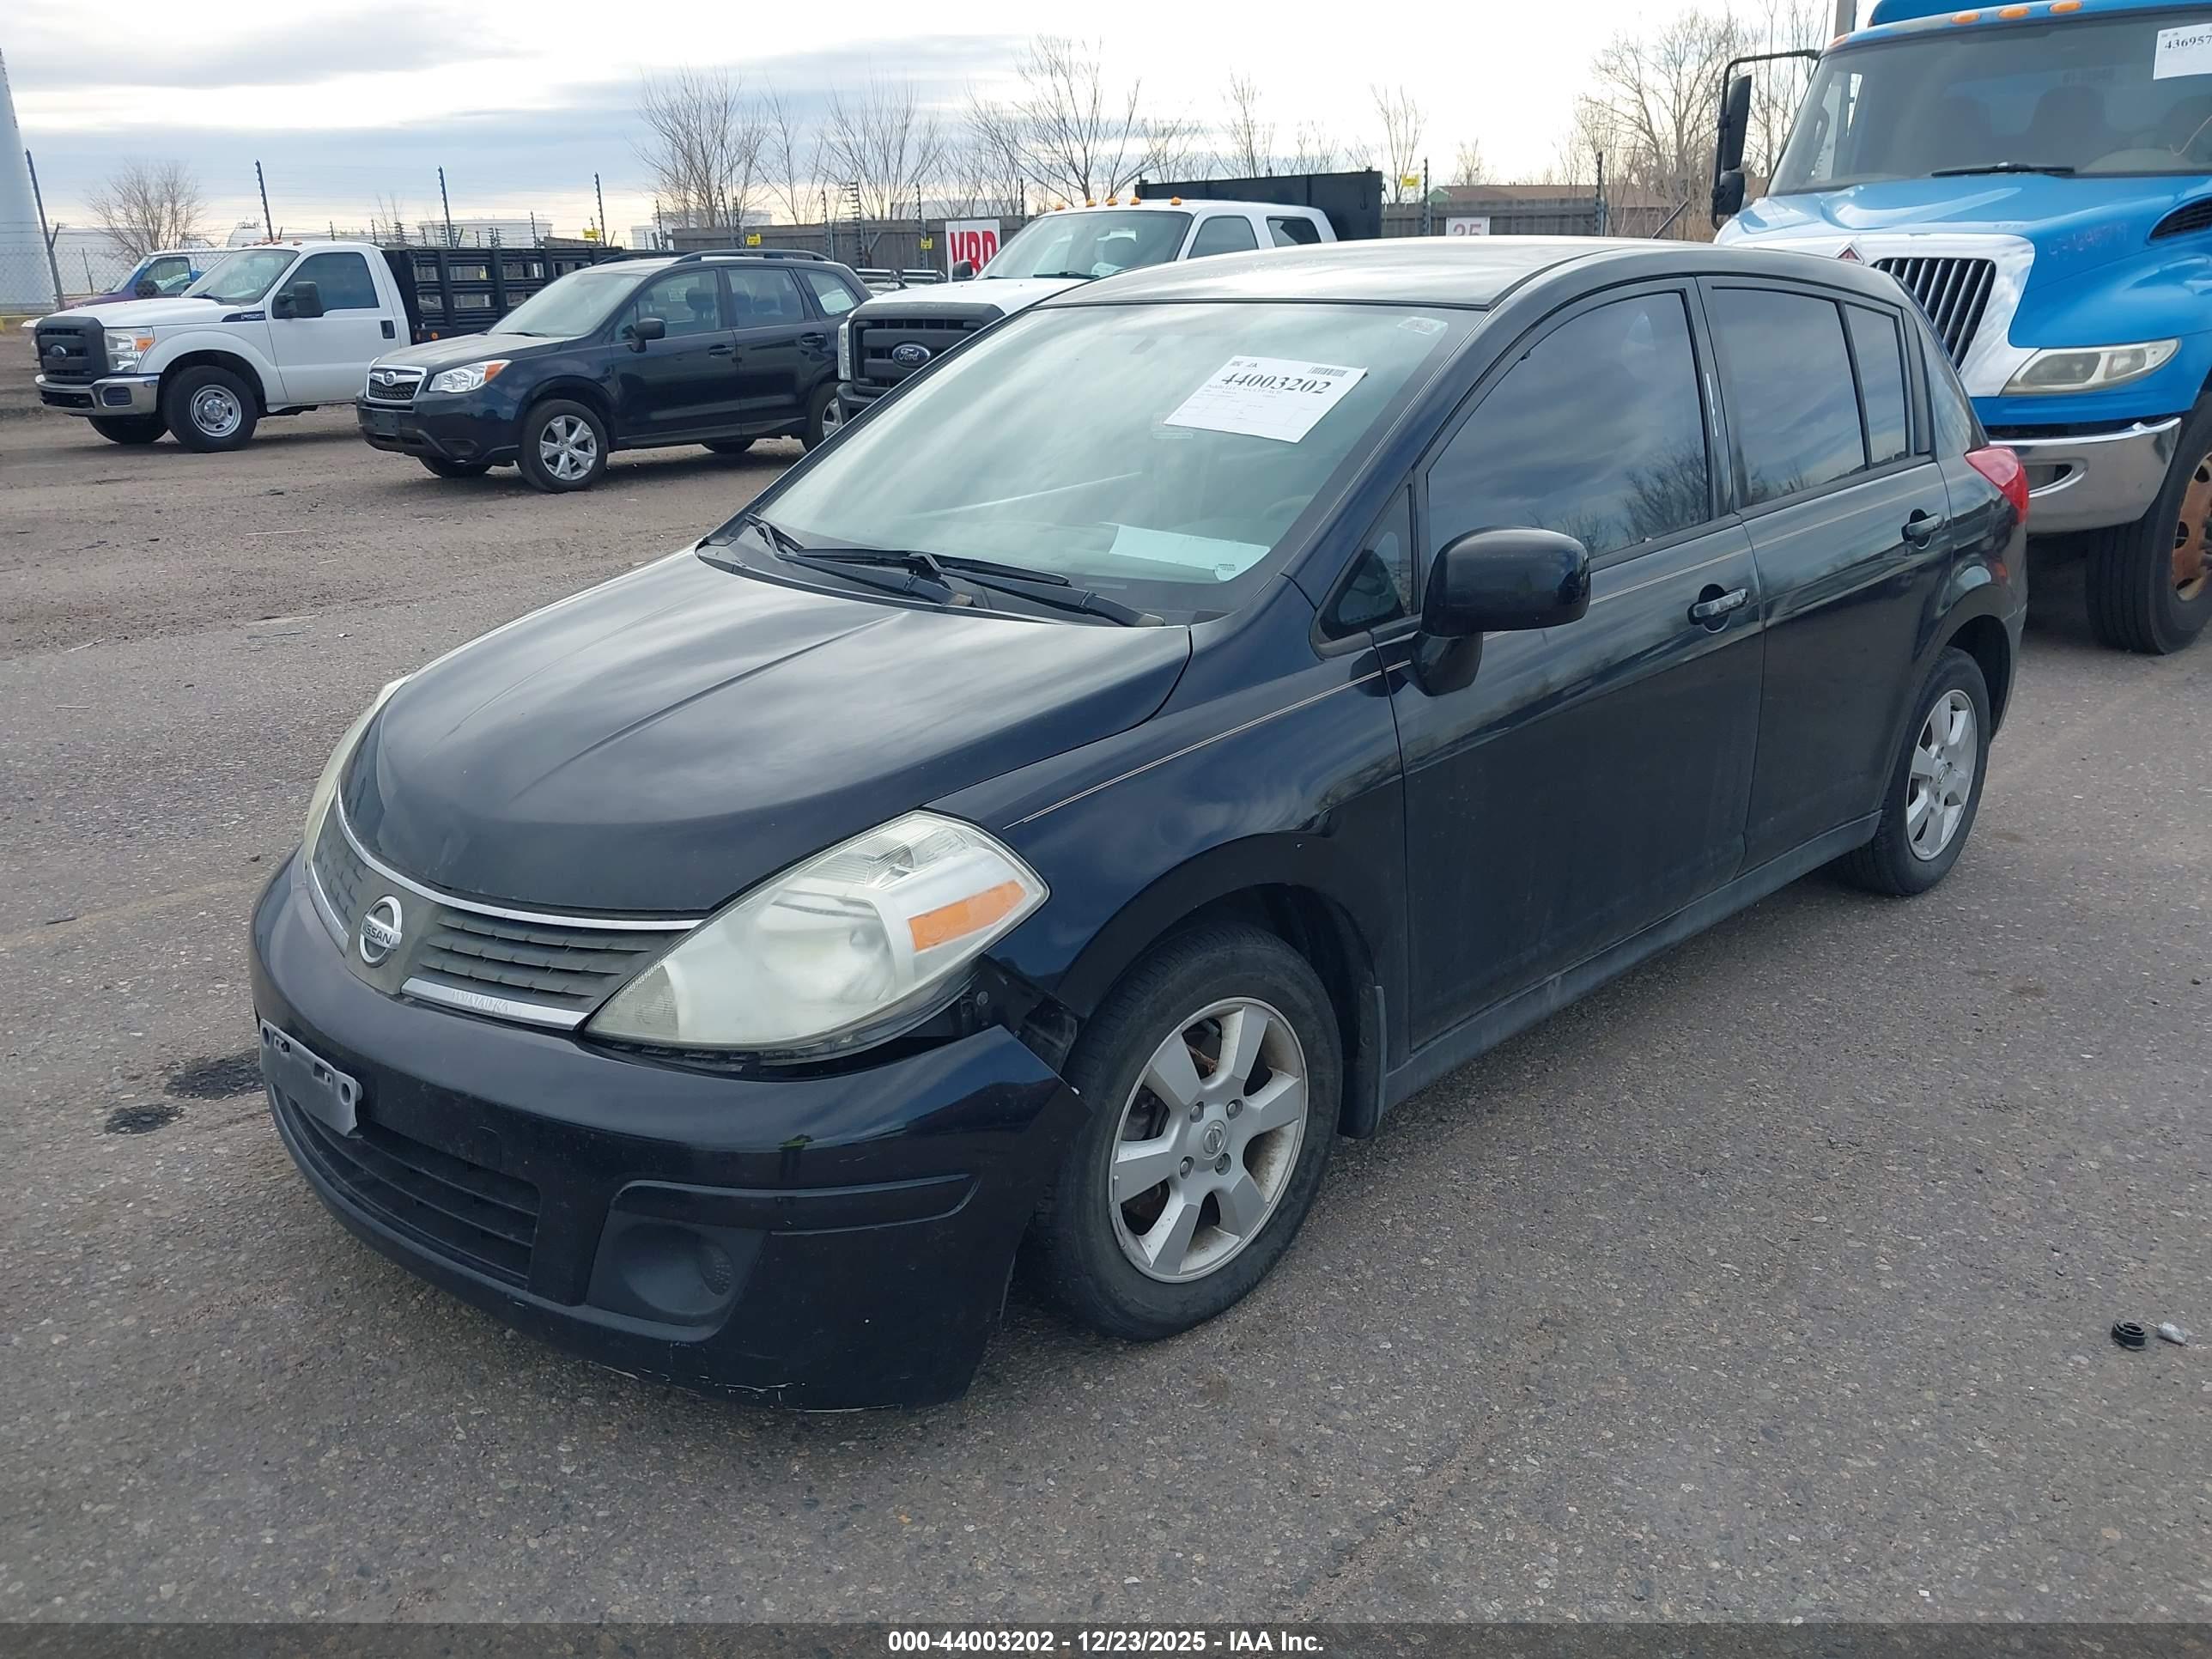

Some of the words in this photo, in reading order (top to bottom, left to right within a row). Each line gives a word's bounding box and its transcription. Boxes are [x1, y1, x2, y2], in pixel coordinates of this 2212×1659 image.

[898, 348, 920, 362] Ford
[1221, 372, 1332, 394] 44003202
[362, 924, 392, 945] SSAN
